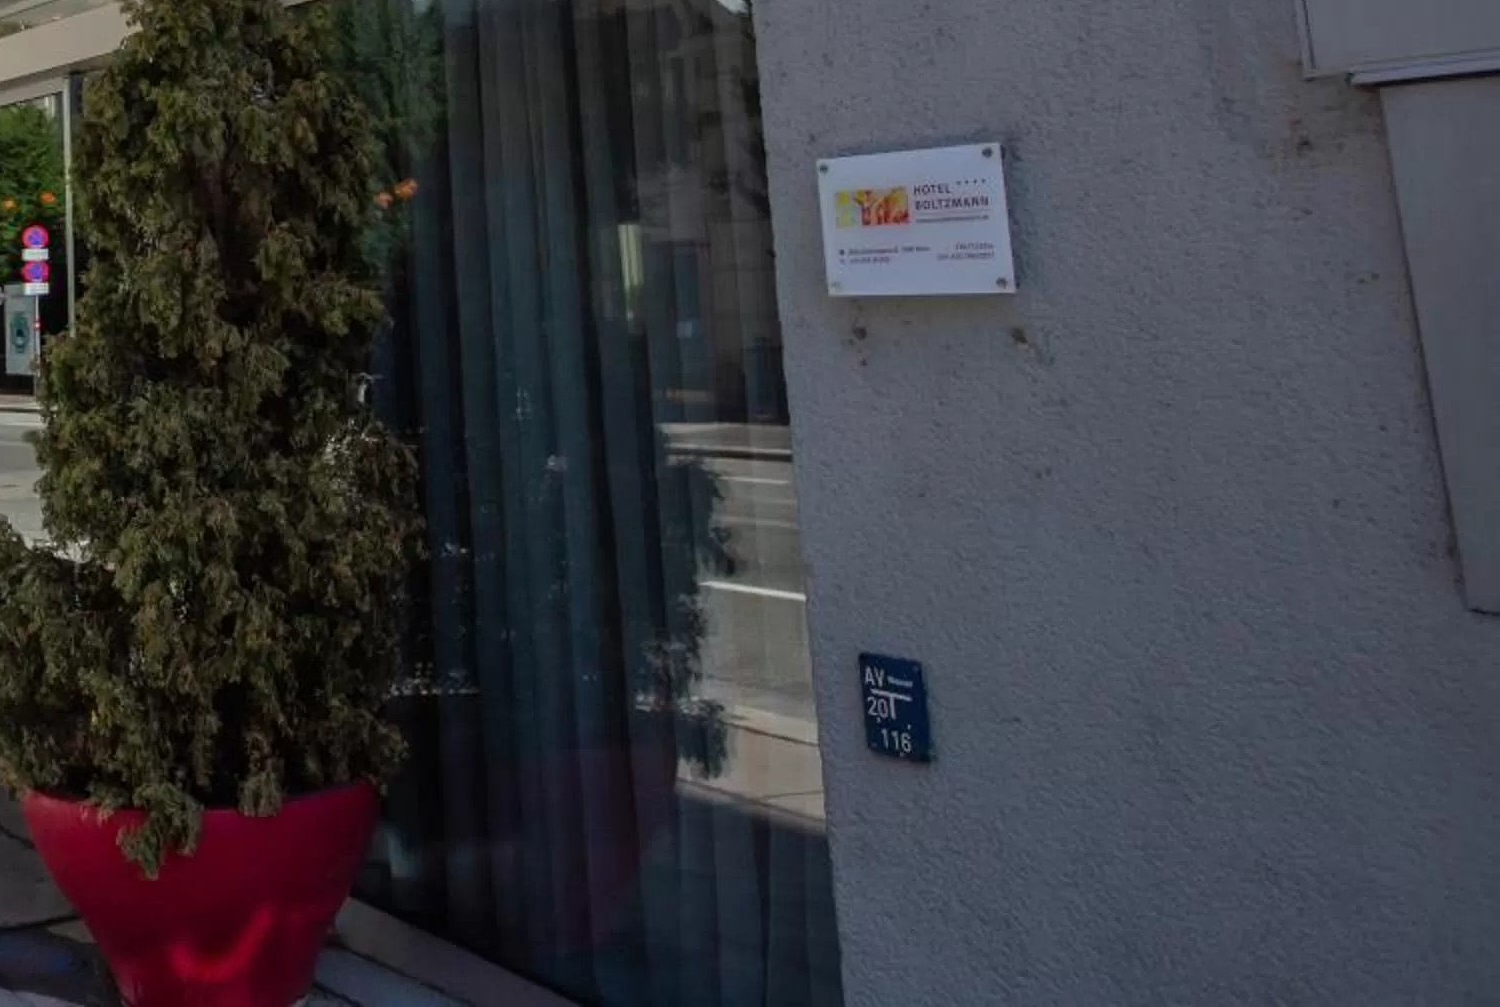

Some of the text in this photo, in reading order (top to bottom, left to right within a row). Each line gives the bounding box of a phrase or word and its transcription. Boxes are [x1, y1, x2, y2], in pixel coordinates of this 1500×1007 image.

[913, 183, 951, 197] HOTEL
[915, 196, 990, 210] BOLTZMANN
[865, 666, 885, 687] AV
